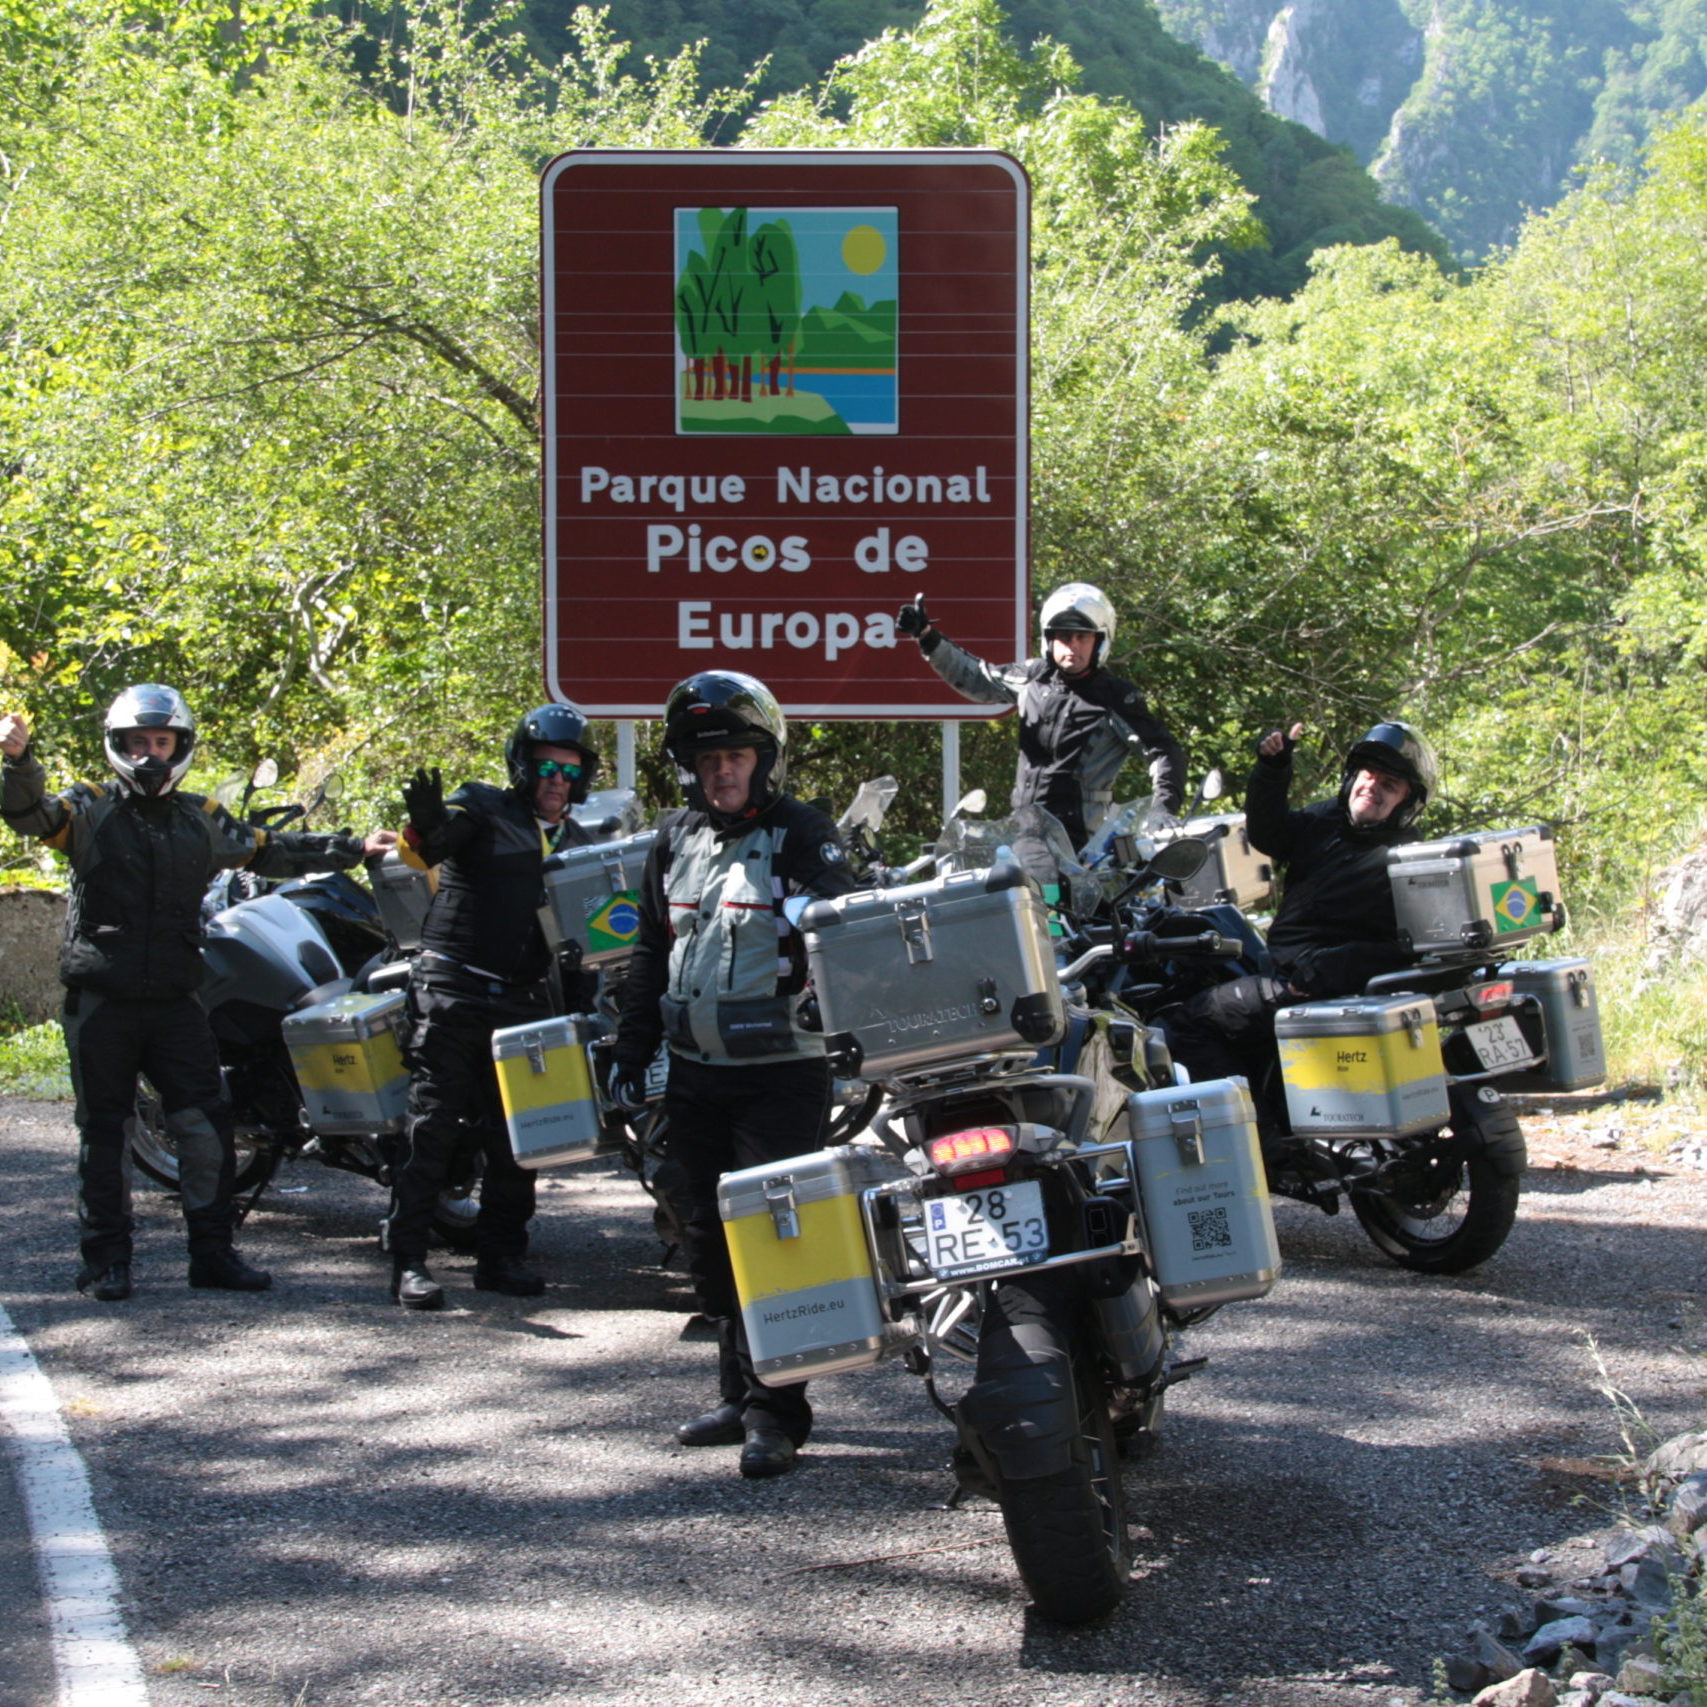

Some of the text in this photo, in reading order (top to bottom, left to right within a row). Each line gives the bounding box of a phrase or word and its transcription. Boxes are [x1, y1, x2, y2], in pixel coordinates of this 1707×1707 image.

[580, 466, 991, 512] Parque Nacional
[647, 523, 929, 573] Picos de
[678, 601, 898, 661] Europa
[1336, 1051, 1367, 1063] Hertz
[964, 1190, 1007, 1225] 28
[934, 1217, 1045, 1265] RE 53
[763, 1299, 845, 1325] HertzRide.eu
